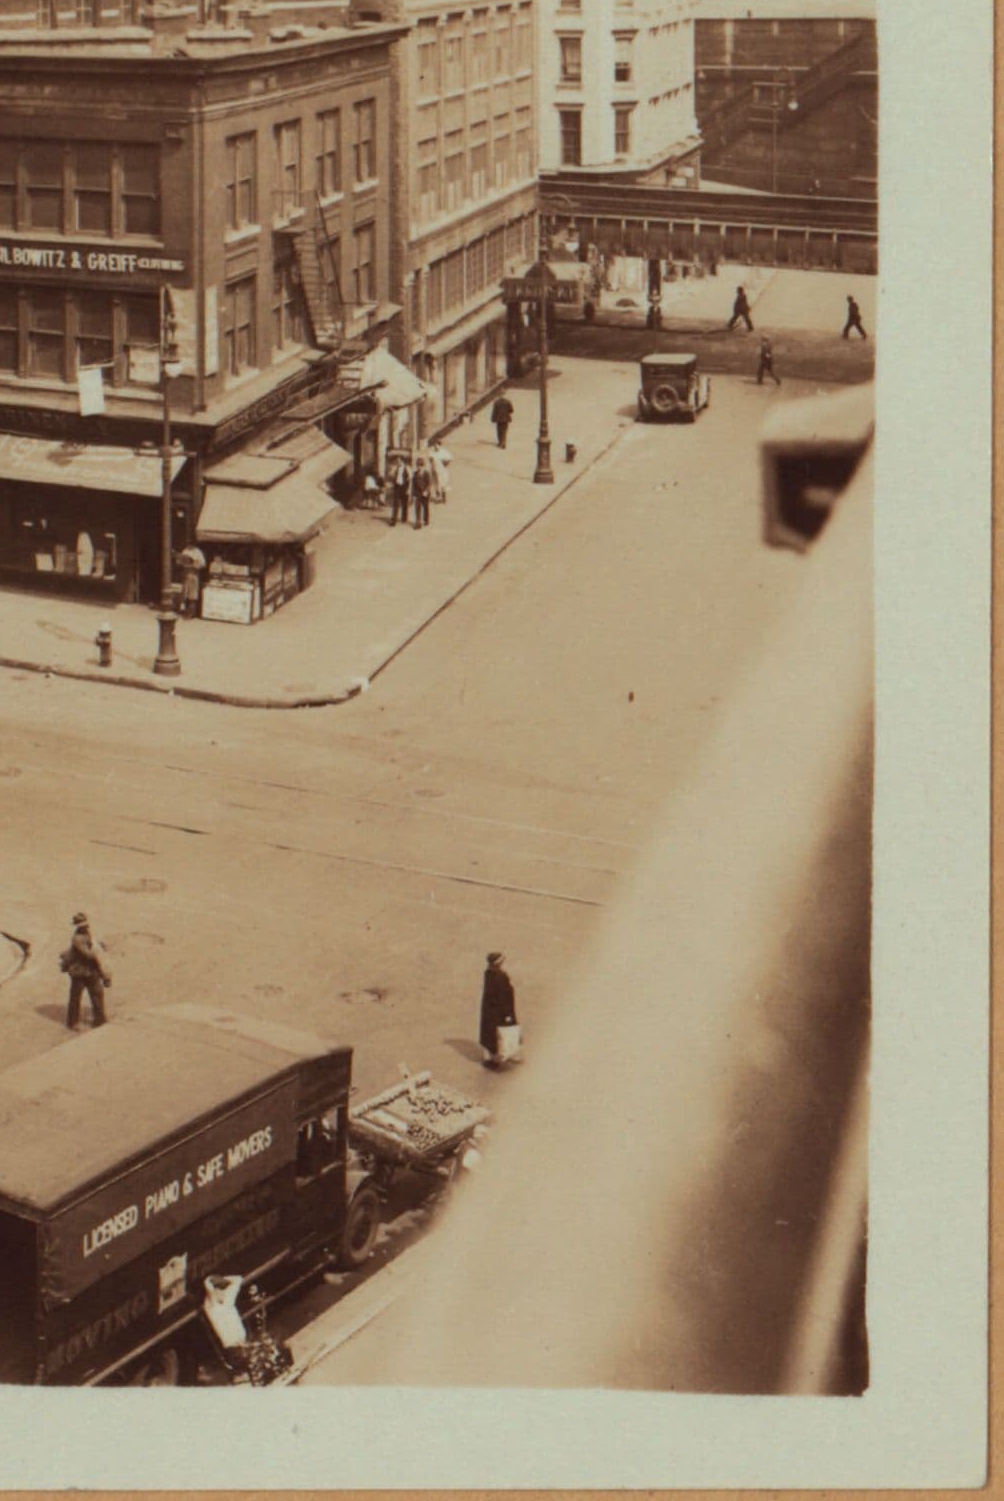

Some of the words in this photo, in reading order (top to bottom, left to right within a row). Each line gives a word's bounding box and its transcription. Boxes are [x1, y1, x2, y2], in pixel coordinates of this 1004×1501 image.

[70, 251, 82, 269] &
[82, 1204, 139, 1259] LICENSED
[145, 1180, 180, 1220] PIANO
[182, 1171, 194, 1197] &
[197, 1152, 225, 1188] SAFE
[227, 1125, 273, 1171] MOVERS
